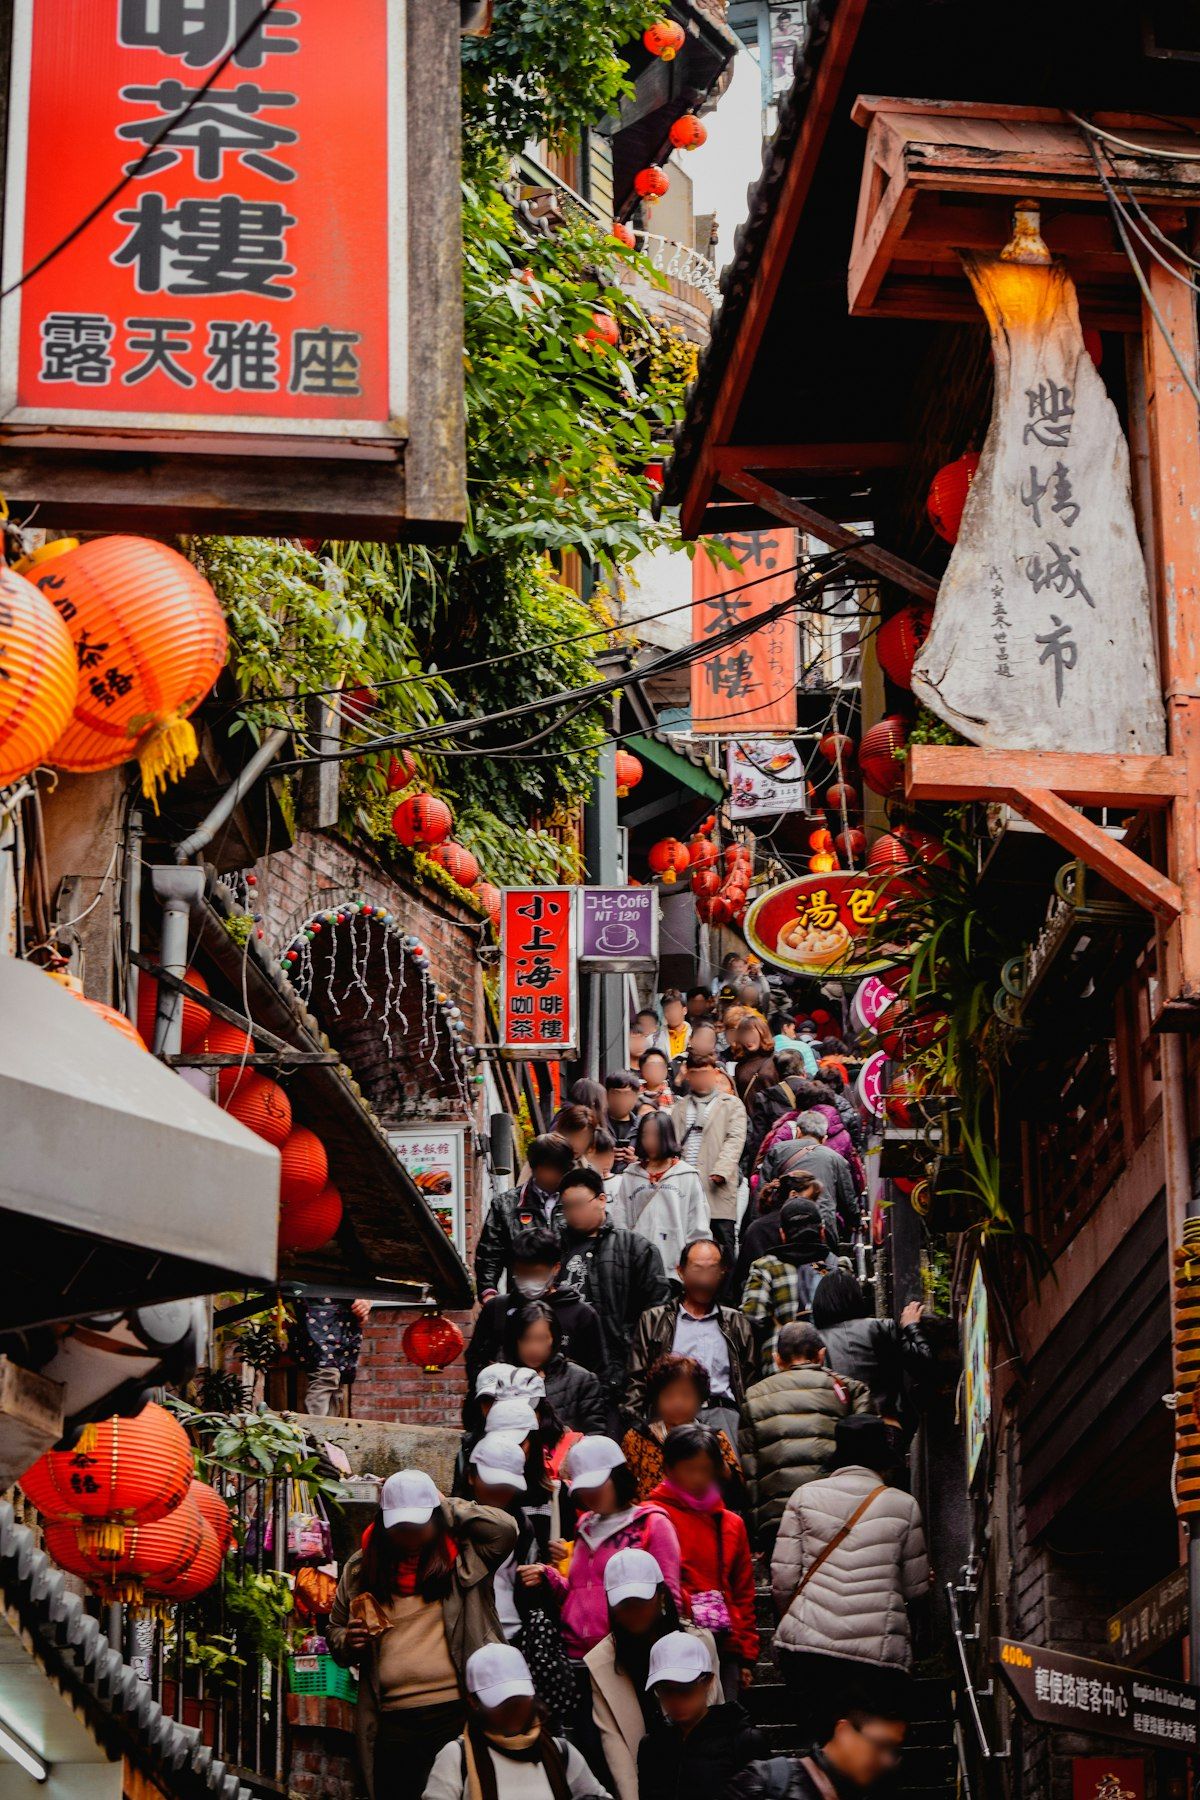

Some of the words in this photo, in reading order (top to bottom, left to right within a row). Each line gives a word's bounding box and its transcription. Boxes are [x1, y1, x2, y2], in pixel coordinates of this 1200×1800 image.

[40, 312, 361, 396] 露天雅座
[1021, 379, 1095, 707] 悲情城市
[796, 888, 888, 929] 湯包
[515, 896, 562, 990] 小上海
[510, 1019, 563, 1039] 茶樓
[511, 996, 563, 1015] 咖啡
[1035, 1666, 1128, 1718] 輕便路遊客中心
